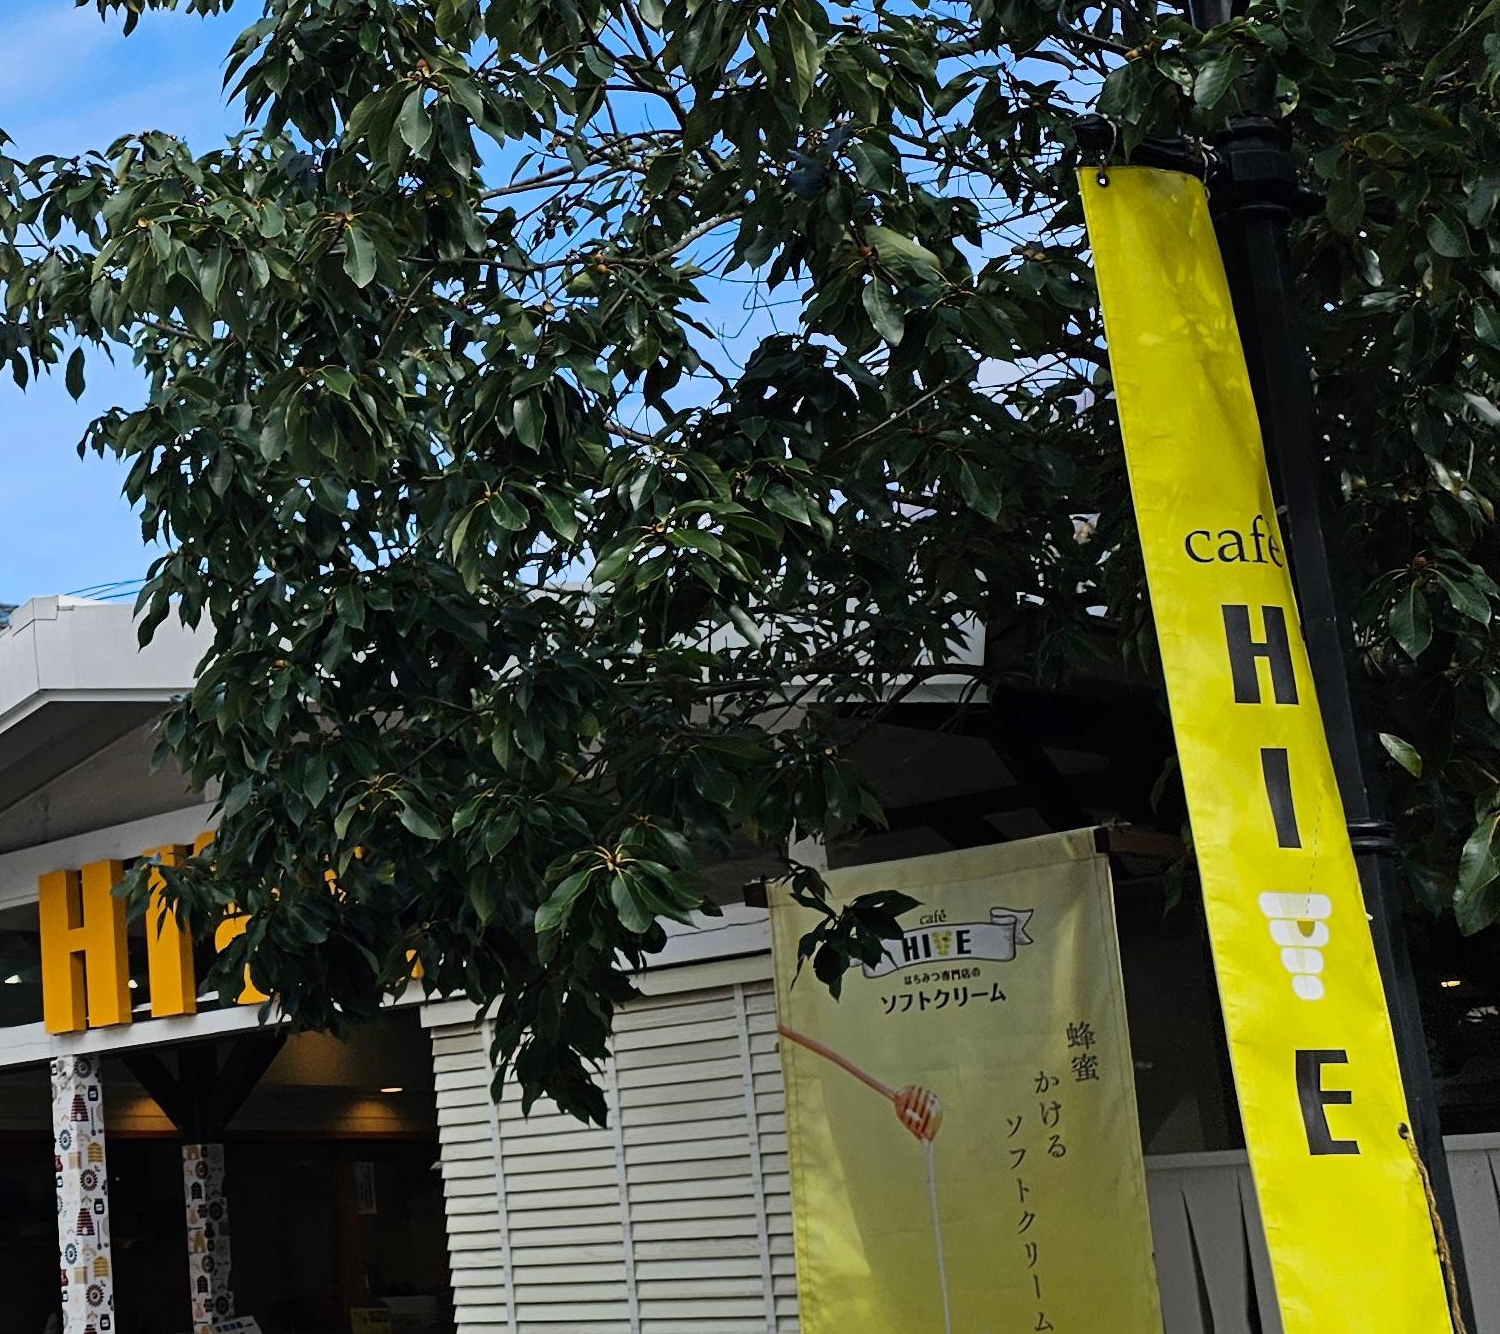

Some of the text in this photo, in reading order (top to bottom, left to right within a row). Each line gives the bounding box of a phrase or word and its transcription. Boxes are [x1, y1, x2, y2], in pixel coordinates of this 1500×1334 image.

[919, 908, 947, 926] café
[881, 982, 1007, 1015] ソフトクリーム
[904, 967, 981, 986] はちみつ専門店の
[1065, 1020, 1100, 1082] 蜂蜜
[1034, 1069, 1067, 1159] かける
[1006, 1114, 1055, 1333] ソフトクリーム
